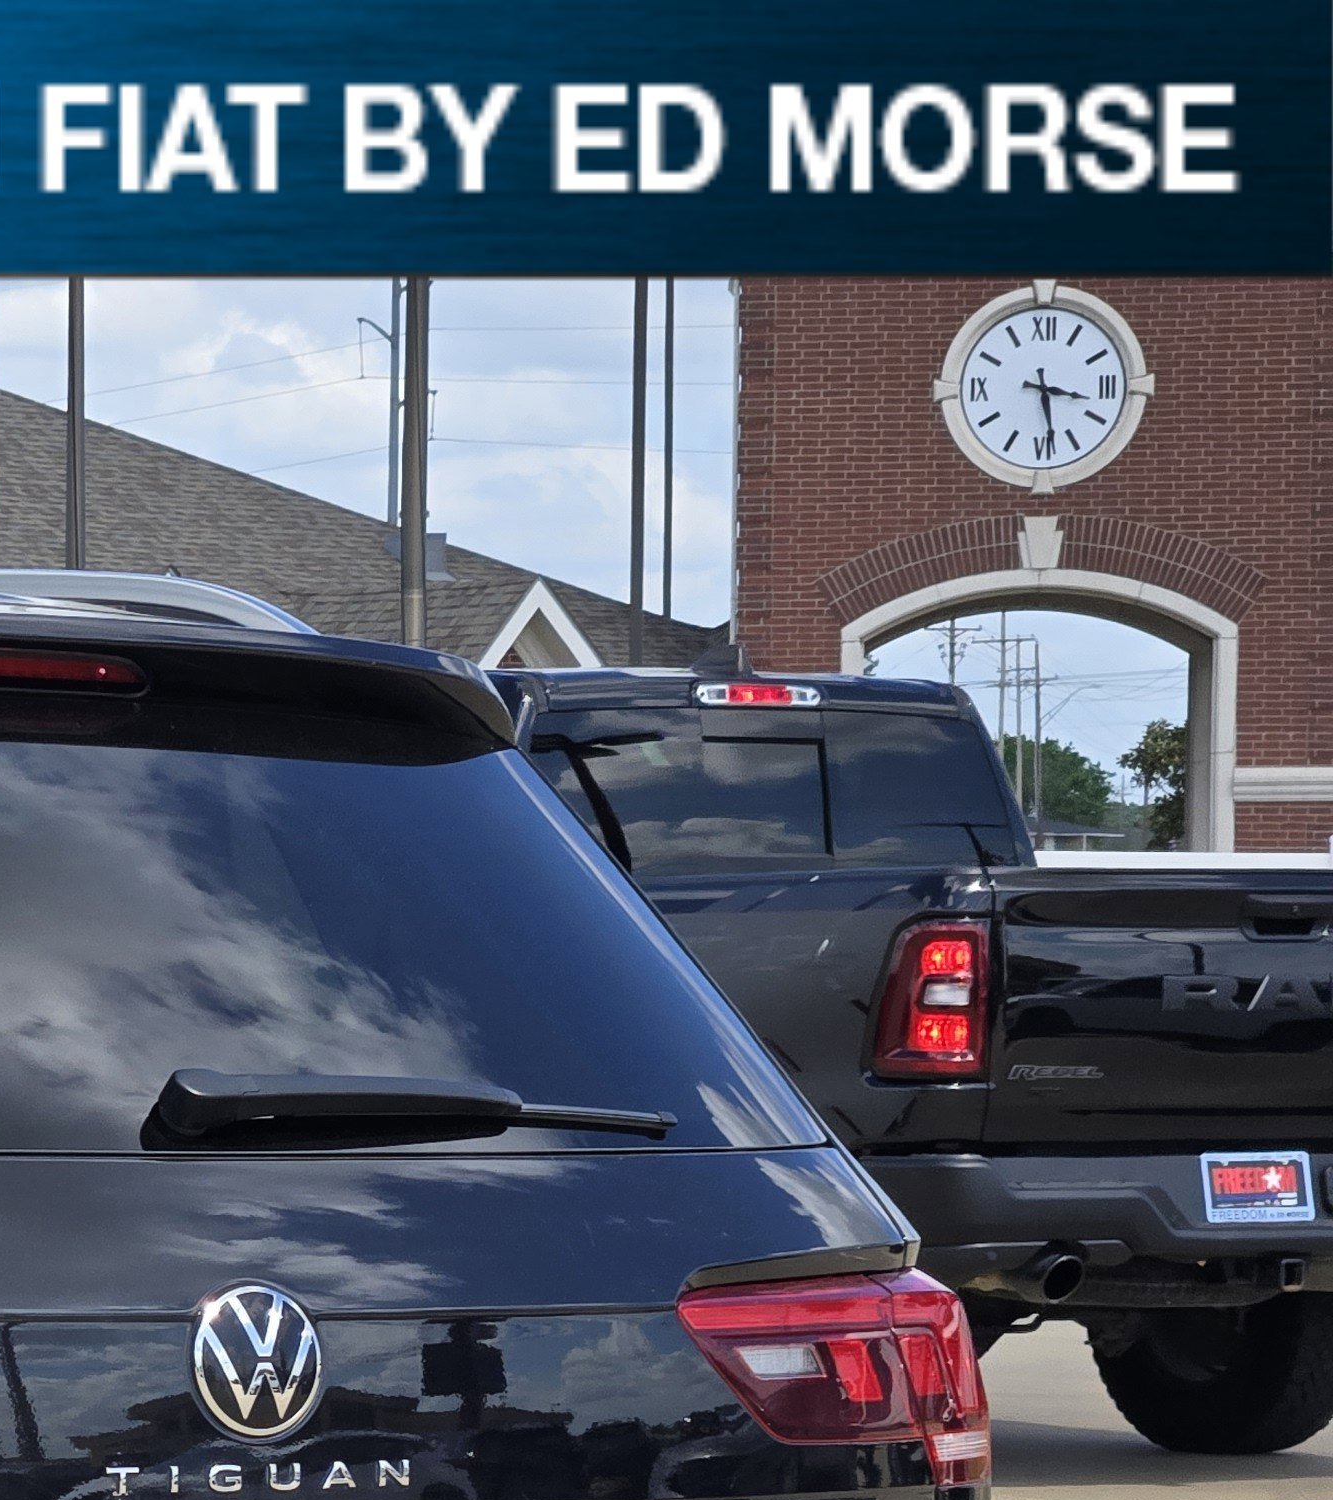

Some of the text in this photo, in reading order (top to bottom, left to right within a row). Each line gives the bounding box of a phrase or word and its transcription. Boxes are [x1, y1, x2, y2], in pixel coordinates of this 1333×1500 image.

[1032, 317, 1057, 341] XII
[970, 377, 989, 402] IX
[1098, 374, 1117, 400] III
[1212, 1165, 1298, 1194] FREEDOM
[1212, 1209, 1267, 1221] FREEDOM
[105, 1459, 411, 1496] TIGUAN
